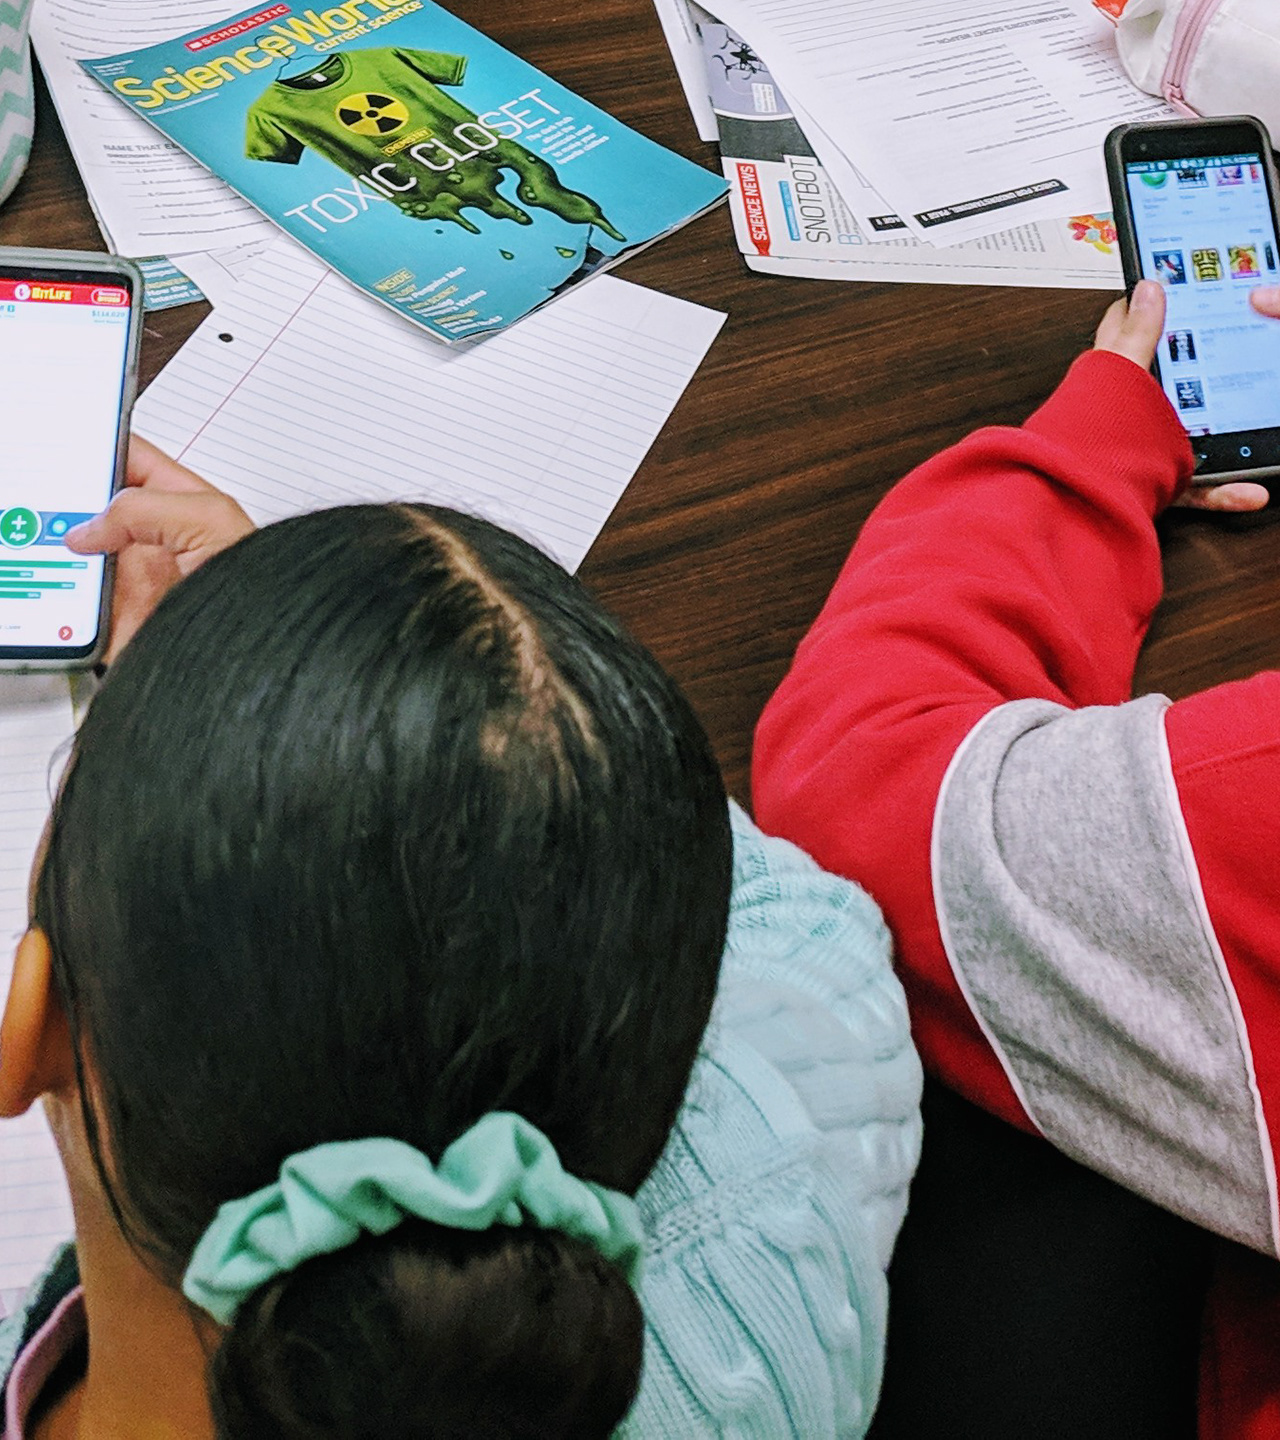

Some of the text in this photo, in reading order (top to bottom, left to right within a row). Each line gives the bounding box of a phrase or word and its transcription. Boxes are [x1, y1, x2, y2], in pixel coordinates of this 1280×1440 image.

[201, 6, 289, 47] SCHOLASTIC
[284, 88, 560, 233] TOXIC CLOSET
[789, 158, 832, 244] SNOTBOT
[740, 165, 768, 241] SCIENCE NEWS
